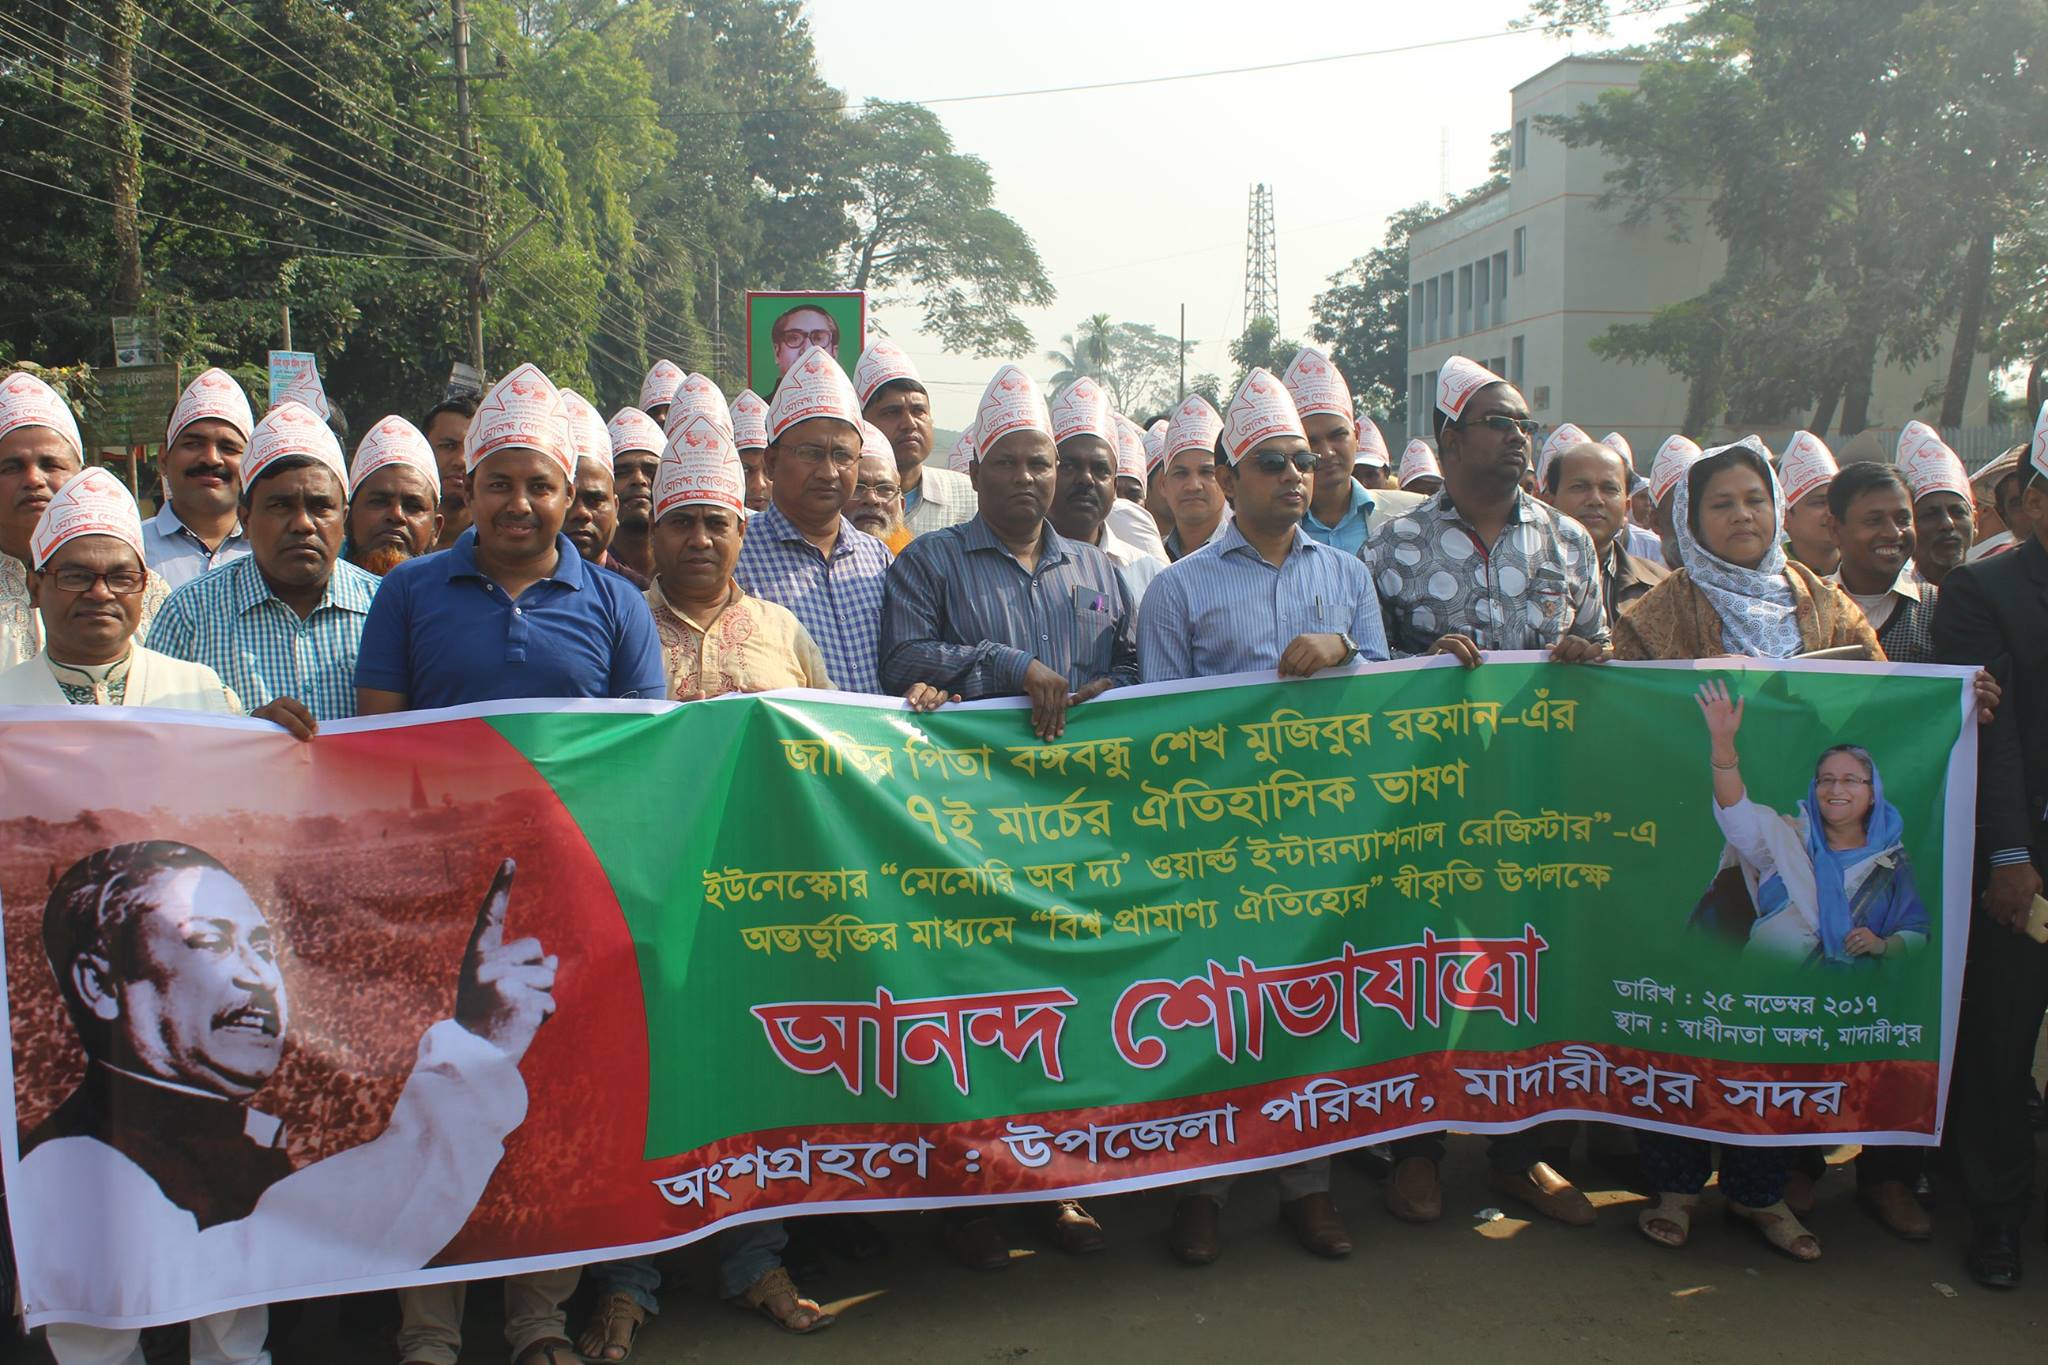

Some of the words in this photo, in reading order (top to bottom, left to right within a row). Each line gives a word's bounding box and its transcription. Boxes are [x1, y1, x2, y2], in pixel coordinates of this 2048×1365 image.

[779, 731, 894, 779] জাতির
[903, 738, 993, 781] পিতা
[1006, 737, 1133, 780] বঙ্গবন্ধু
[1150, 724, 1227, 765] শেখ
[1240, 709, 1372, 761] মুজিবুর
[1387, 688, 1578, 743] রহমান-এঁর
[907, 794, 979, 847] ৭ই
[989, 787, 1111, 844] মার্চের
[1133, 770, 1356, 832] ঐতিহাসিক
[1369, 758, 1470, 805] ভাষণ
[703, 866, 868, 910] ইউনেস্কোর
[1025, 864, 1075, 892] অব
[1146, 836, 1239, 881] ওয়ার্ল্ড
[1247, 820, 1445, 872] ইন্টারন্যাশনাল
[740, 913, 898, 961] অন্তর্ভুক্তির
[908, 917, 1014, 950] মাধ্যমে
[1113, 899, 1218, 938] প্রামাণ্য
[1391, 861, 1485, 909] স্বীকৃতি
[1495, 861, 1612, 893] উপলক্ষে
[749, 986, 1079, 1098] আনন্দ
[1112, 922, 1548, 1070] শোভাযাত্রা
[1612, 978, 1675, 1005] তারিখ
[1702, 991, 1734, 1011] ২৫
[1742, 993, 1815, 1016] নভেম্বর
[1823, 994, 1878, 1016] ২০১৭
[1612, 1010, 1652, 1036] স্থান
[1678, 1017, 1766, 1046] স্বাধীনতা
[1839, 1019, 1923, 1048] মাদারীপুর
[652, 1136, 936, 1208] অংশগ্রহণে
[1000, 1104, 1241, 1170] উপজেলা
[1260, 1072, 1436, 1132] পরিষদ,
[1454, 1045, 1702, 1113] মাদারীপুর
[1717, 1079, 1846, 1118] সদর
